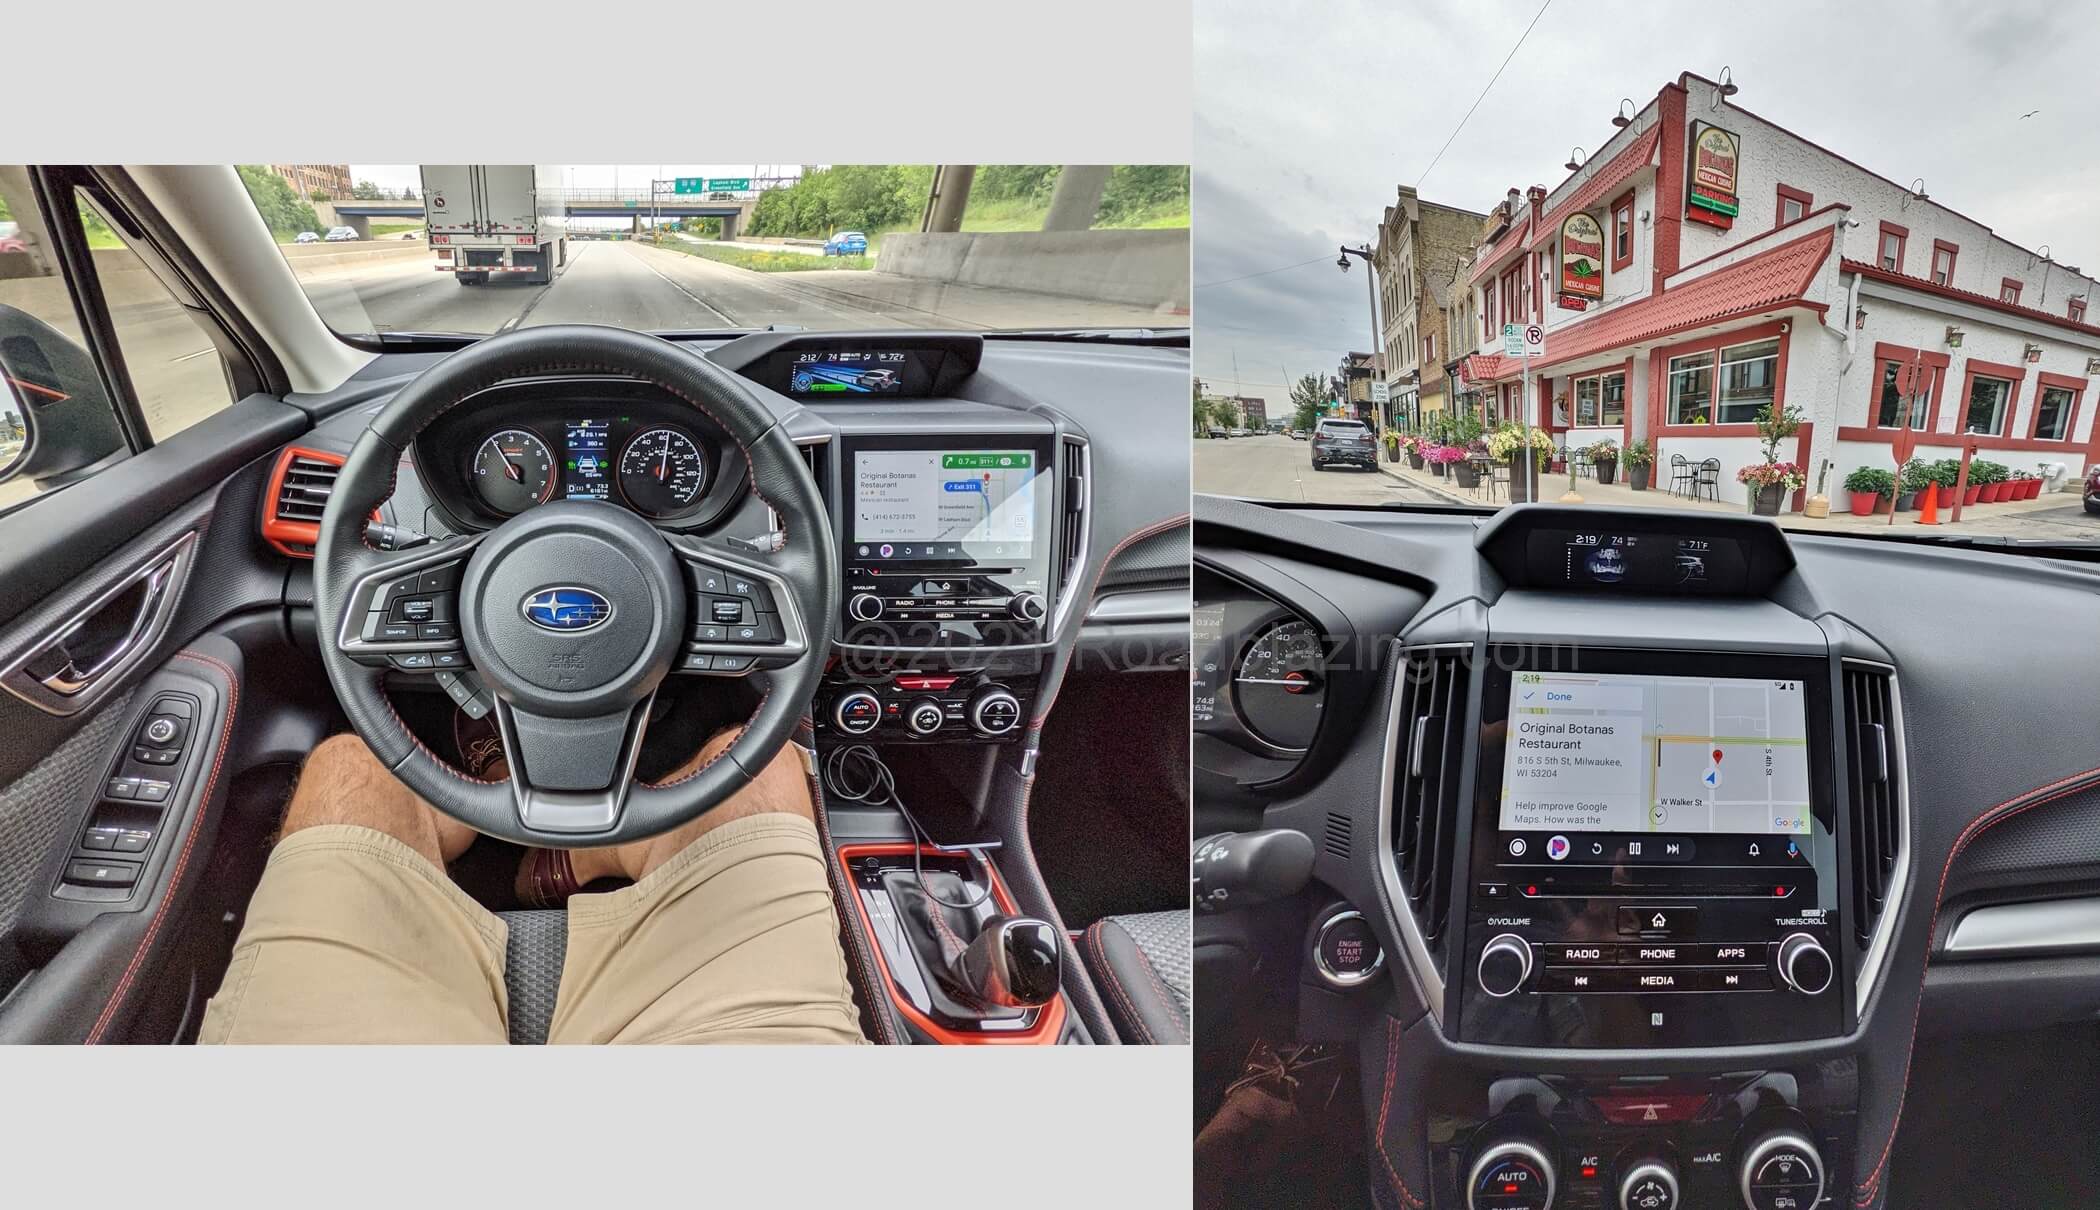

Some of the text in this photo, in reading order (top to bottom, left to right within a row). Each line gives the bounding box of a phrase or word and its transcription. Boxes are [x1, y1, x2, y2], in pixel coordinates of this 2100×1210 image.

[1699, 171, 1717, 183] MEXICAN
[1695, 186, 1735, 204] PARKING
[1565, 279, 1600, 291] MEXICAN CUISINE
[1561, 296, 1586, 309] OPEN
[828, 353, 838, 361] 74
[508, 435, 514, 443] 3
[860, 472, 888, 480] Original
[531, 491, 538, 499] 8
[1611, 536, 1623, 544] 74
[1257, 651, 1272, 659] 20
[1521, 674, 1541, 683] 2:19
[1547, 691, 1572, 701] Done
[1519, 722, 1615, 735] Original Botanas
[1518, 738, 1582, 750] Restaurant
[1517, 756, 1623, 768] 816 S 5th St, Milwaukee,
[1516, 769, 1558, 778] WI 53204
[1766, 768, 1772, 776] St
[1515, 801, 1608, 812] Help improve Google
[1660, 798, 1703, 807] W Walker St
[1514, 815, 1541, 825] Maps.
[1544, 815, 1565, 824] How
[1587, 816, 1601, 824] the
[1775, 917, 1828, 926] TUNE/SCROLL
[1336, 948, 1362, 956] START
[1566, 949, 1600, 959] RADIO
[1640, 949, 1676, 959] PHONE
[1717, 948, 1745, 958] APPS
[1339, 955, 1361, 964] STOP
[1641, 976, 1674, 986] MEDIA
[1580, 1157, 1598, 1166] A/C
[1706, 1153, 1721, 1163] A/C
[1497, 1172, 1527, 1182] AUTO
